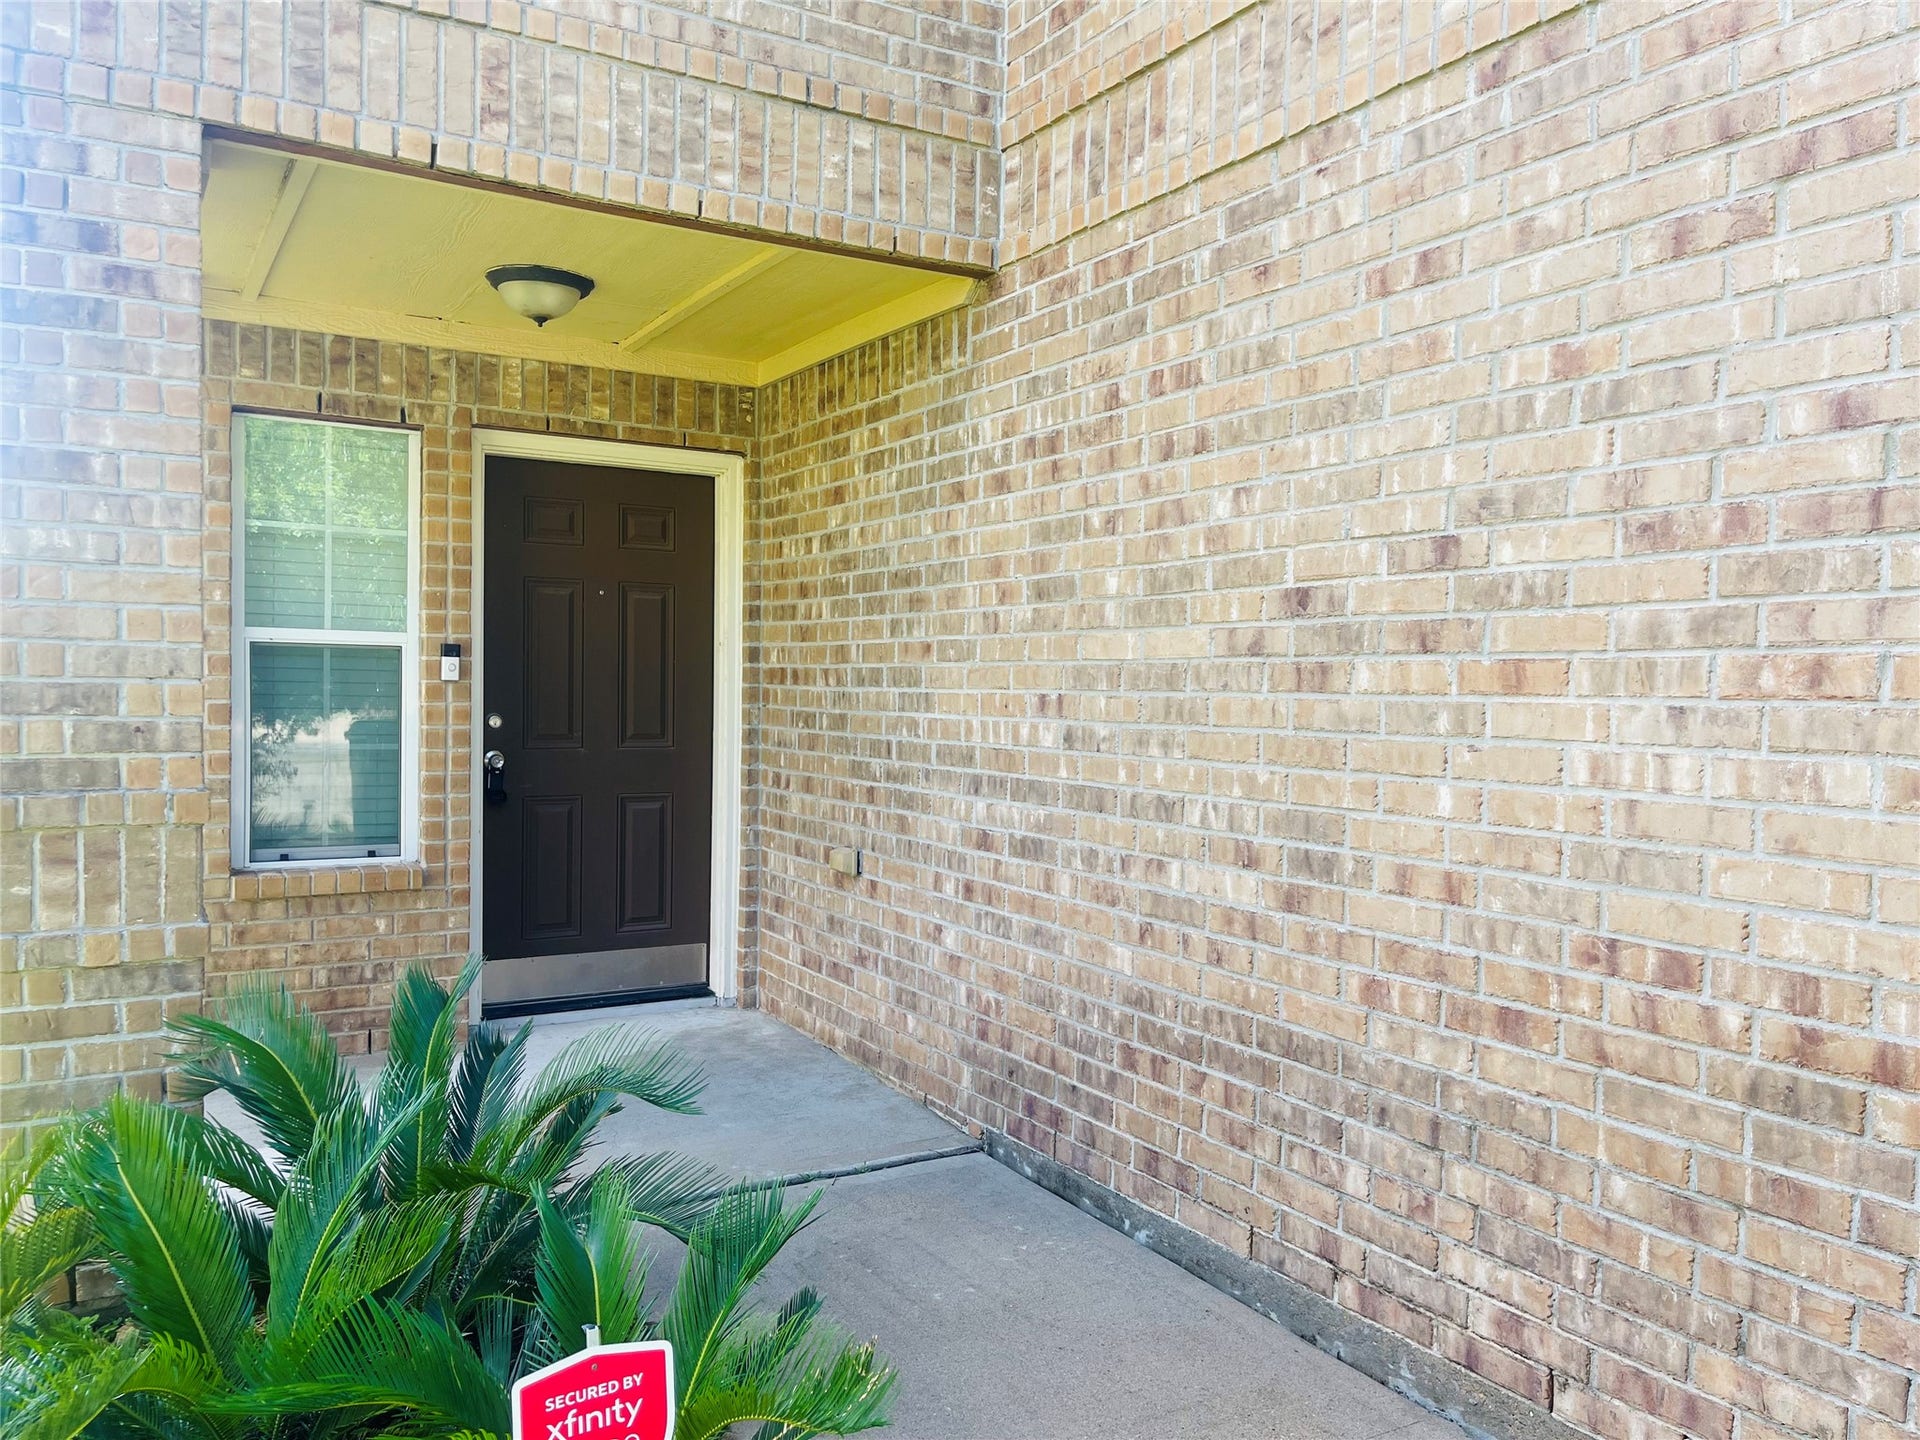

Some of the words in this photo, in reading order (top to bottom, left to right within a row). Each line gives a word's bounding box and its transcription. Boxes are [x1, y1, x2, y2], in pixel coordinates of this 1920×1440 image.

[545, 1380, 619, 1412] SECURED
[623, 1373, 643, 1390] BY
[546, 1398, 643, 1440] xfinity
